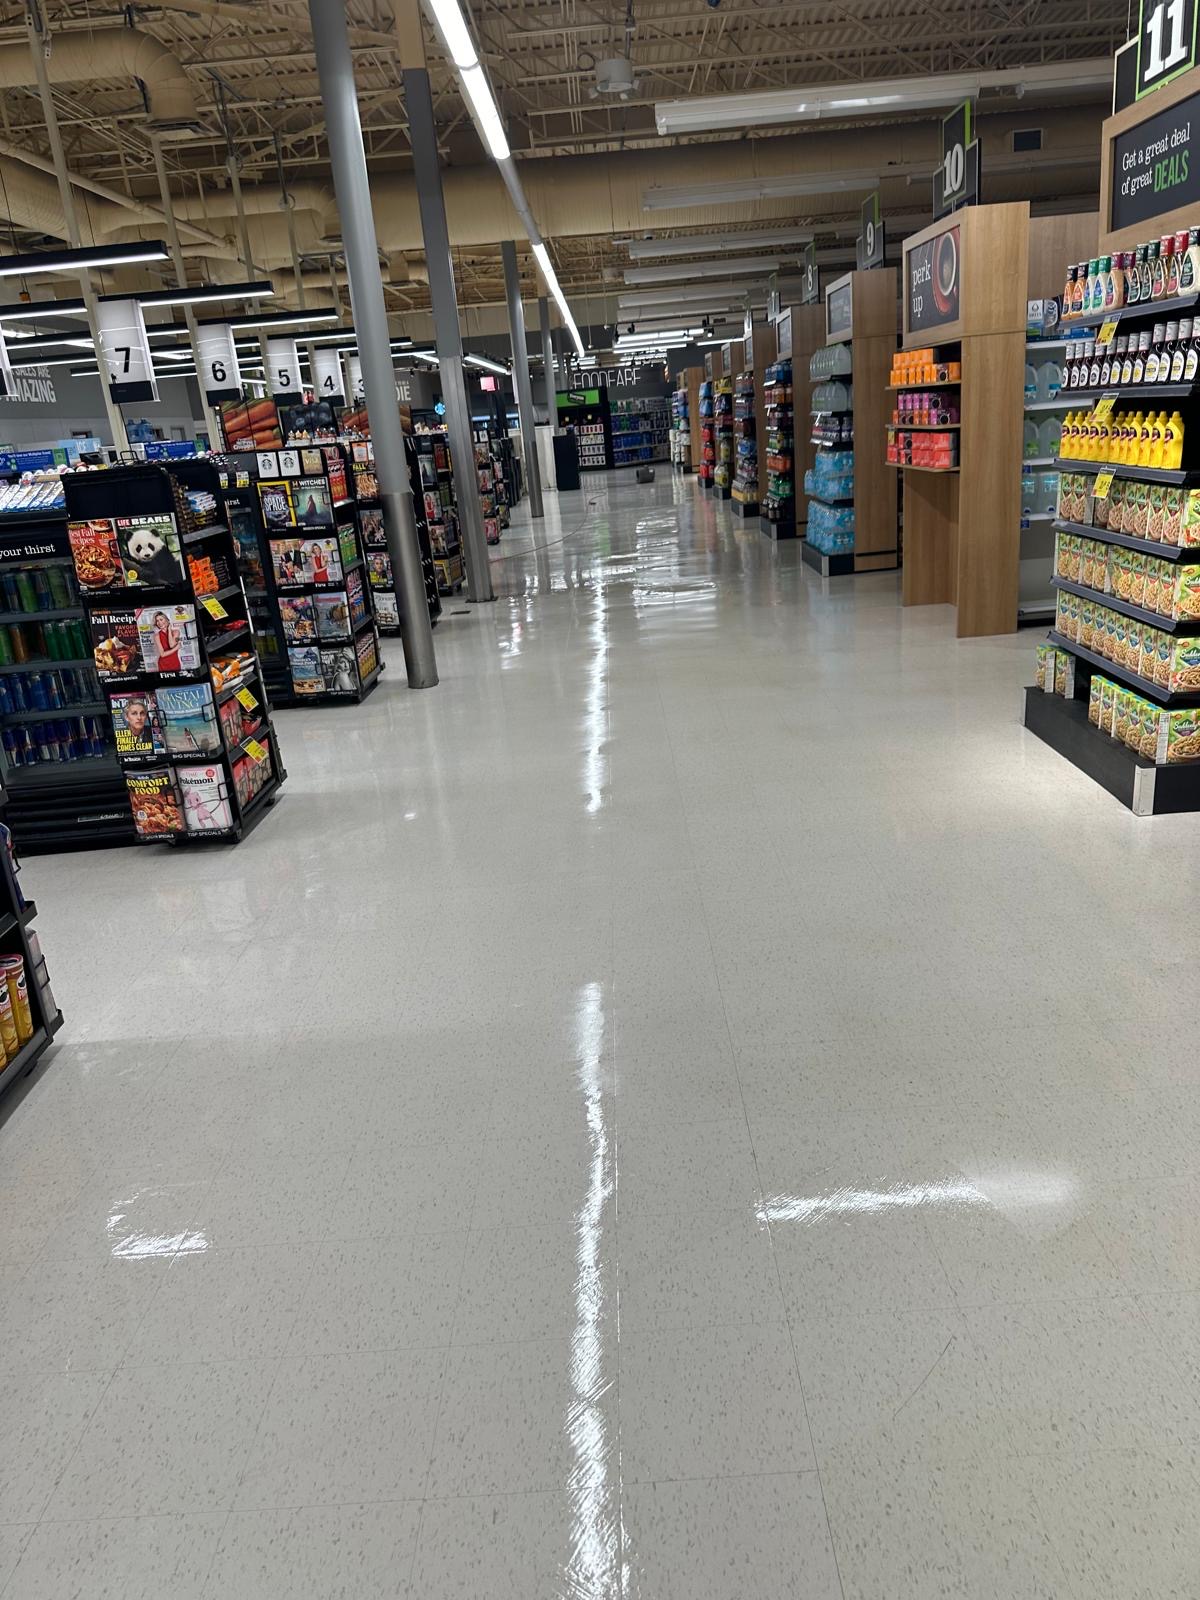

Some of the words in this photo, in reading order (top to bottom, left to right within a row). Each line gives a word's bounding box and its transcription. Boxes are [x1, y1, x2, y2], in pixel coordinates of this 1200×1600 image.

[1144, 0, 1188, 82] 11
[1122, 149, 1137, 171] Get
[1137, 149, 1144, 164] a
[1145, 133, 1169, 165] great
[1170, 122, 1190, 148] deal
[943, 143, 964, 195] 10
[1121, 176, 1131, 196] of
[1130, 167, 1153, 196] great
[1154, 149, 1189, 193] DEALS
[866, 221, 875, 257] 9
[807, 264, 813, 291] 8
[912, 259, 931, 292] perk
[912, 297, 923, 318] up
[114, 347, 131, 373] 7
[211, 360, 227, 382] 6
[278, 369, 291, 387] 5
[323, 375, 335, 391] 4
[299, 478, 325, 486] WITCHES
[263, 496, 286, 512] SPACE
[117, 519, 130, 527] LIFE
[131, 515, 170, 526] BEARS
[0, 548, 22, 560] your
[24, 543, 56, 555] thirst
[91, 615, 109, 625] Fall
[115, 729, 132, 738] ELLEN
[116, 736, 138, 745] FINALLY
[116, 742, 136, 752] COMES
[135, 741, 153, 751] CLEAN
[126, 777, 169, 787] COMFORT
[134, 787, 160, 795] FOOD
